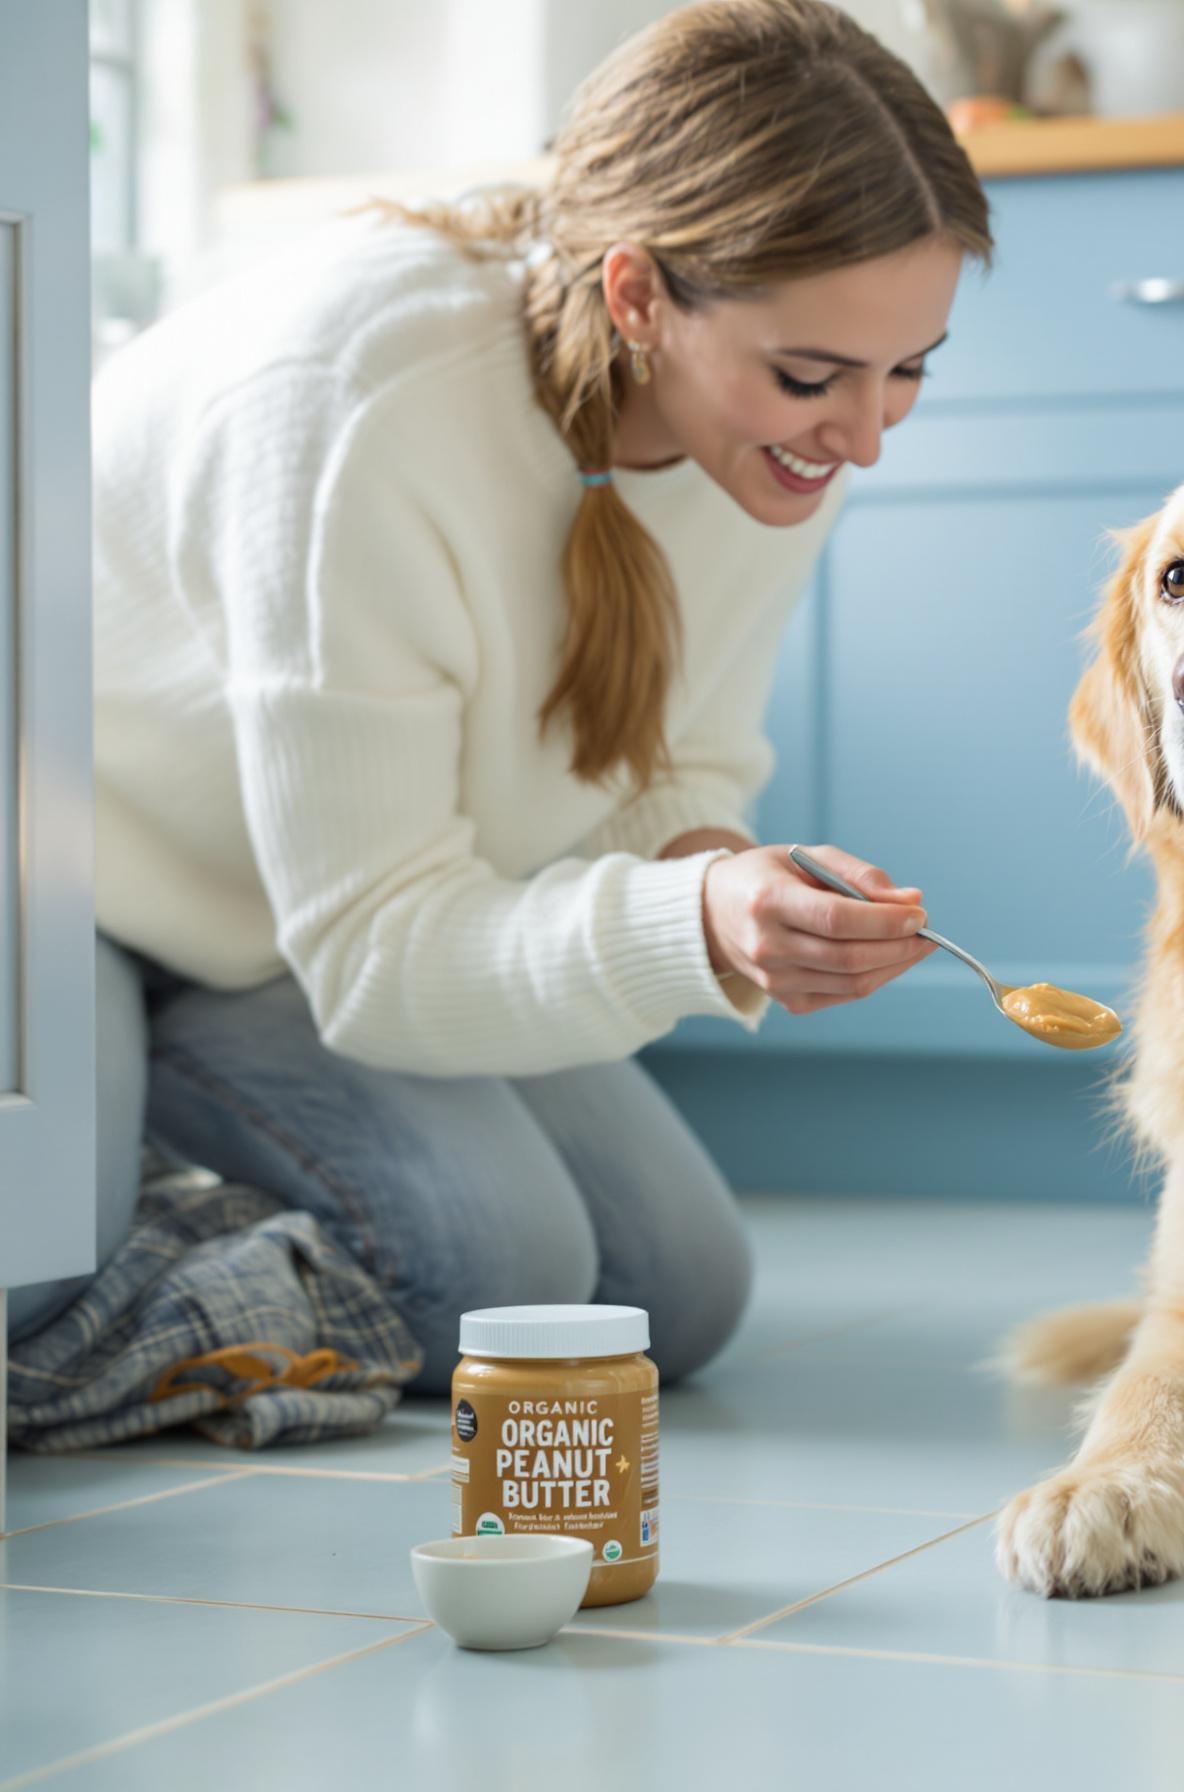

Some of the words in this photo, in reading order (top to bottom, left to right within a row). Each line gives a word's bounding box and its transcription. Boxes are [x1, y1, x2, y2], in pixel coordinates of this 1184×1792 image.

[508, 1400, 598, 1415] ORGANIC
[501, 1418, 614, 1447] ORGANIC
[496, 1448, 612, 1479] PEANUT
[502, 1479, 611, 1509] BUTTER
